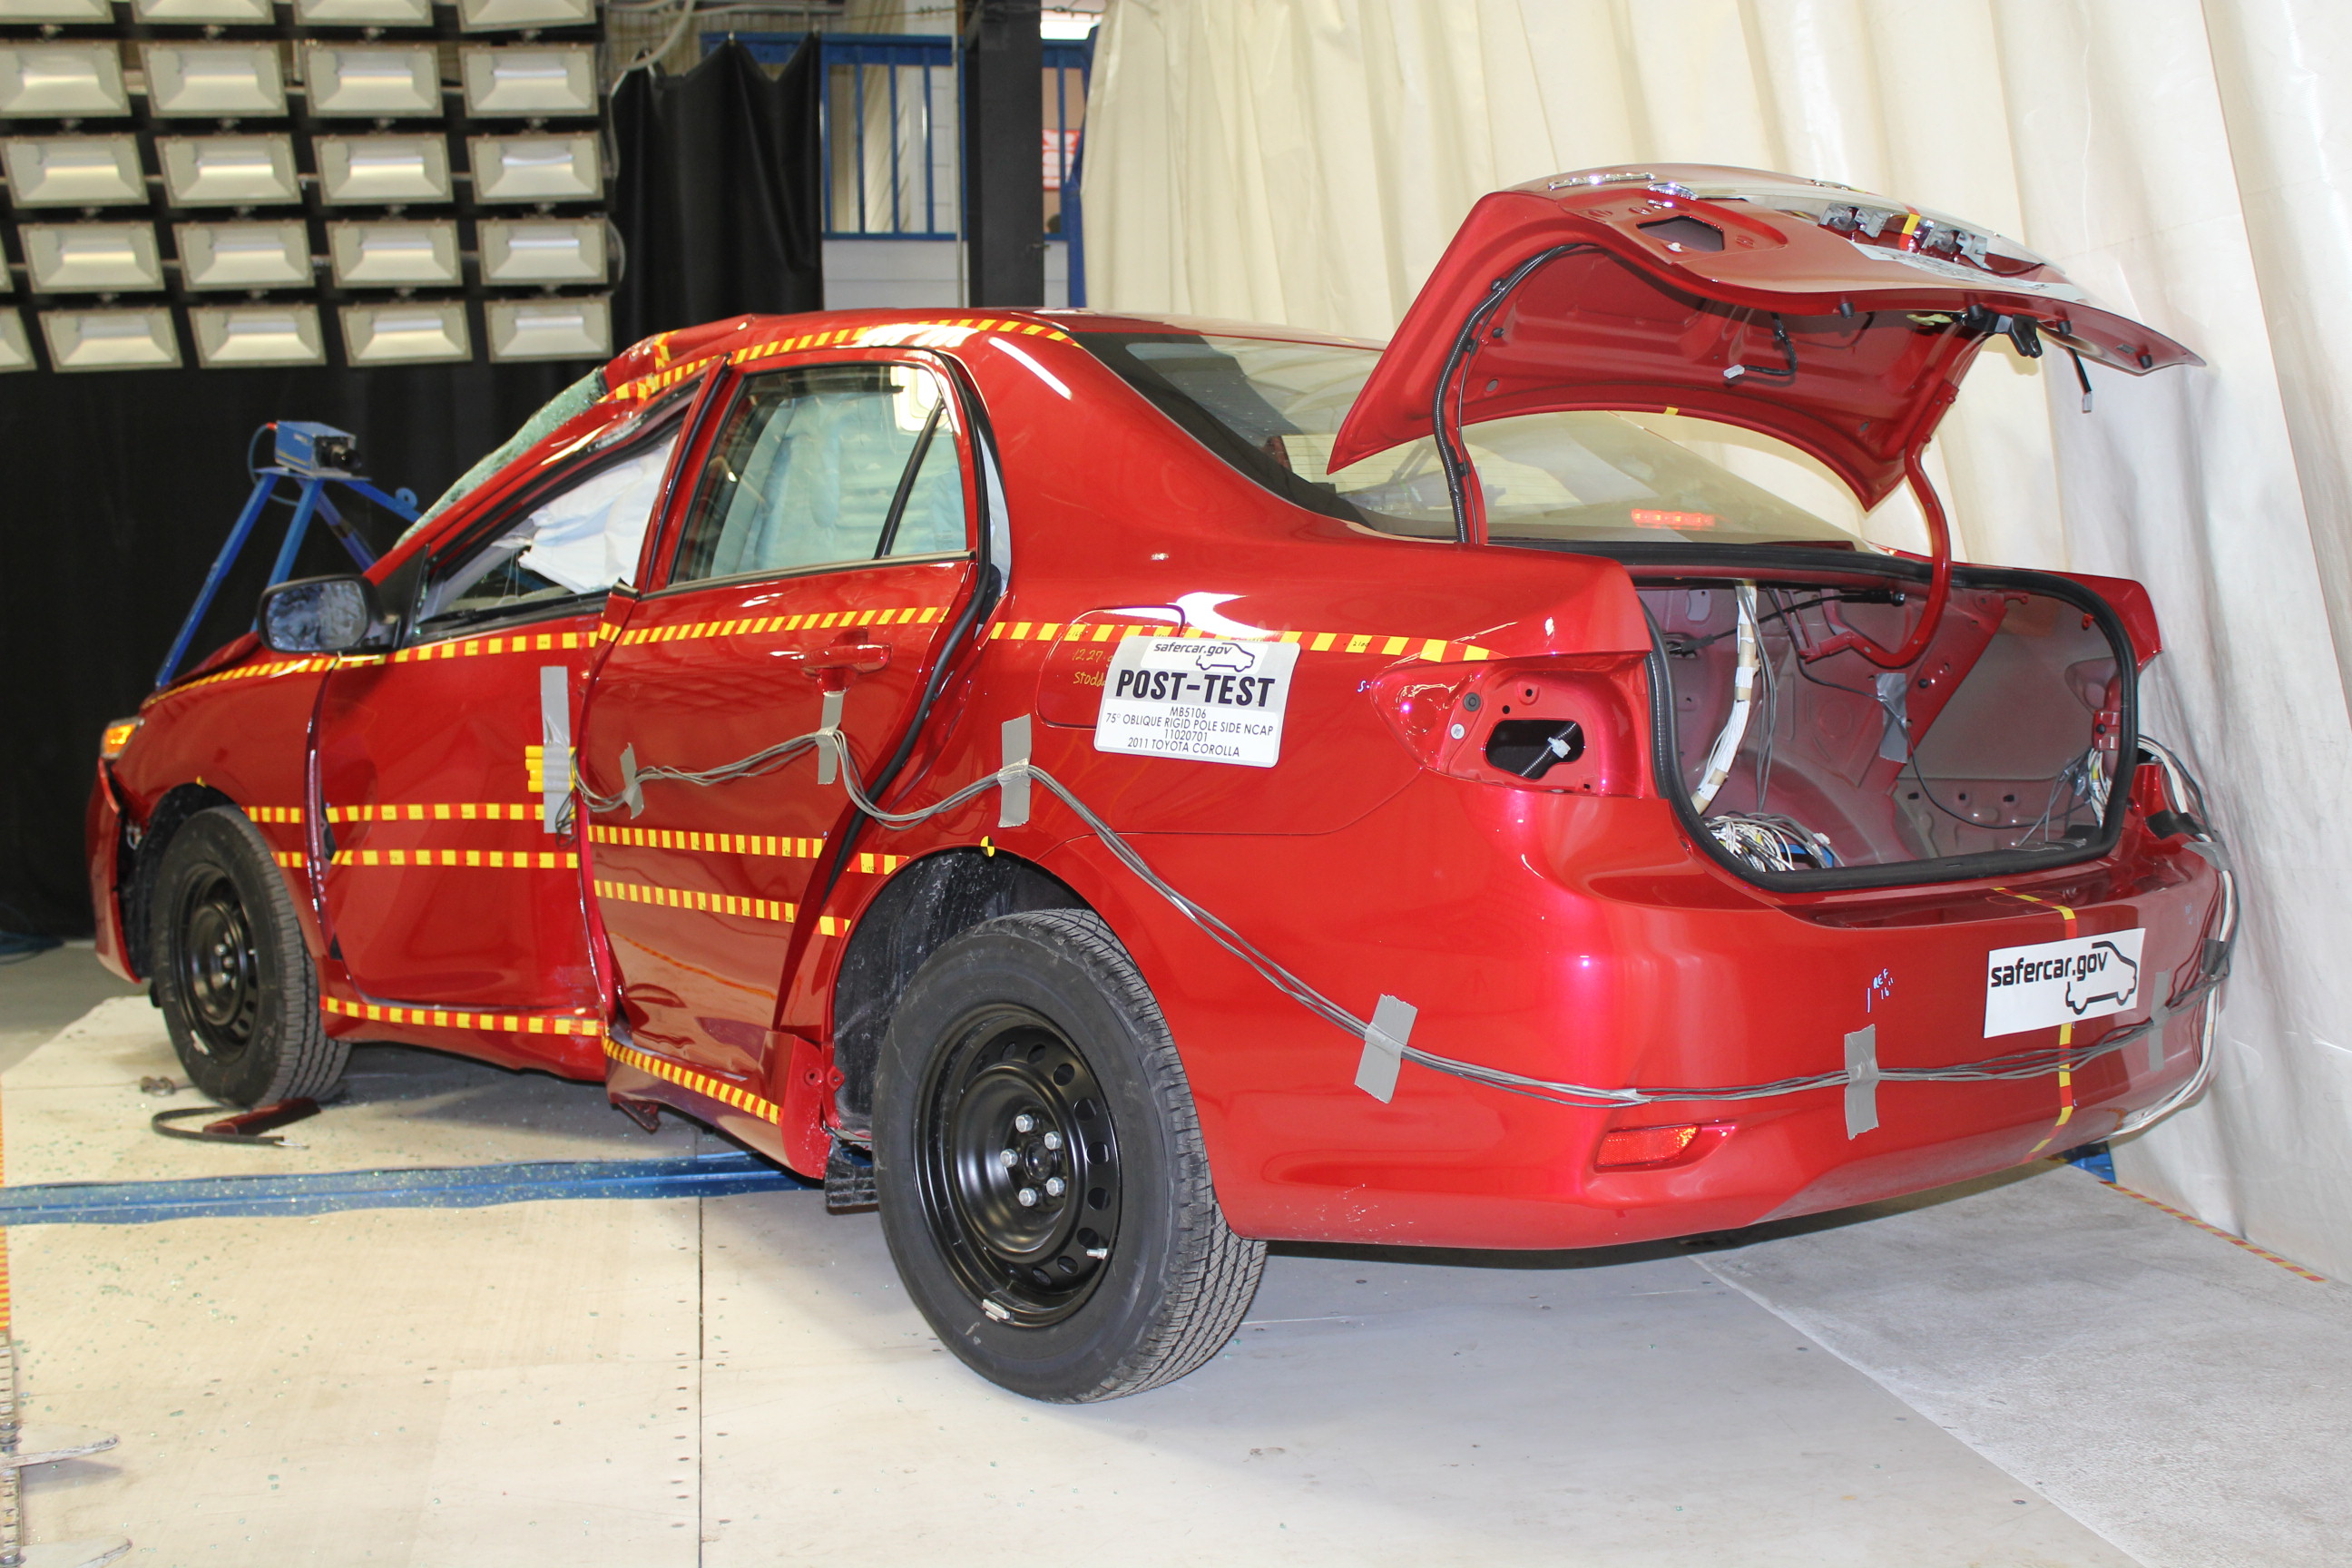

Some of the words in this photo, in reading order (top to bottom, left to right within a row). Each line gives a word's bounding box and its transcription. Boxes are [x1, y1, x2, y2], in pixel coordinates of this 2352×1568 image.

[1153, 642, 1232, 656] safercar.gov
[1073, 671, 1105, 687] Stodd
[1115, 669, 1276, 708] POST-TEST
[1170, 706, 1207, 719] MB5106
[1105, 712, 1121, 723] 75°
[1122, 714, 1162, 727] OBLIQUE
[1164, 718, 1191, 730] RIGID
[1193, 720, 1218, 731] POLE
[1220, 721, 1241, 733] SIDE
[1243, 723, 1274, 737] NCAP
[1164, 729, 1208, 742] 11020701
[1127, 737, 1149, 749] 2011
[1152, 739, 1189, 752] TOYOTA
[1192, 743, 1240, 757] COROLLA
[1991, 951, 2108, 987] safercar.gov
